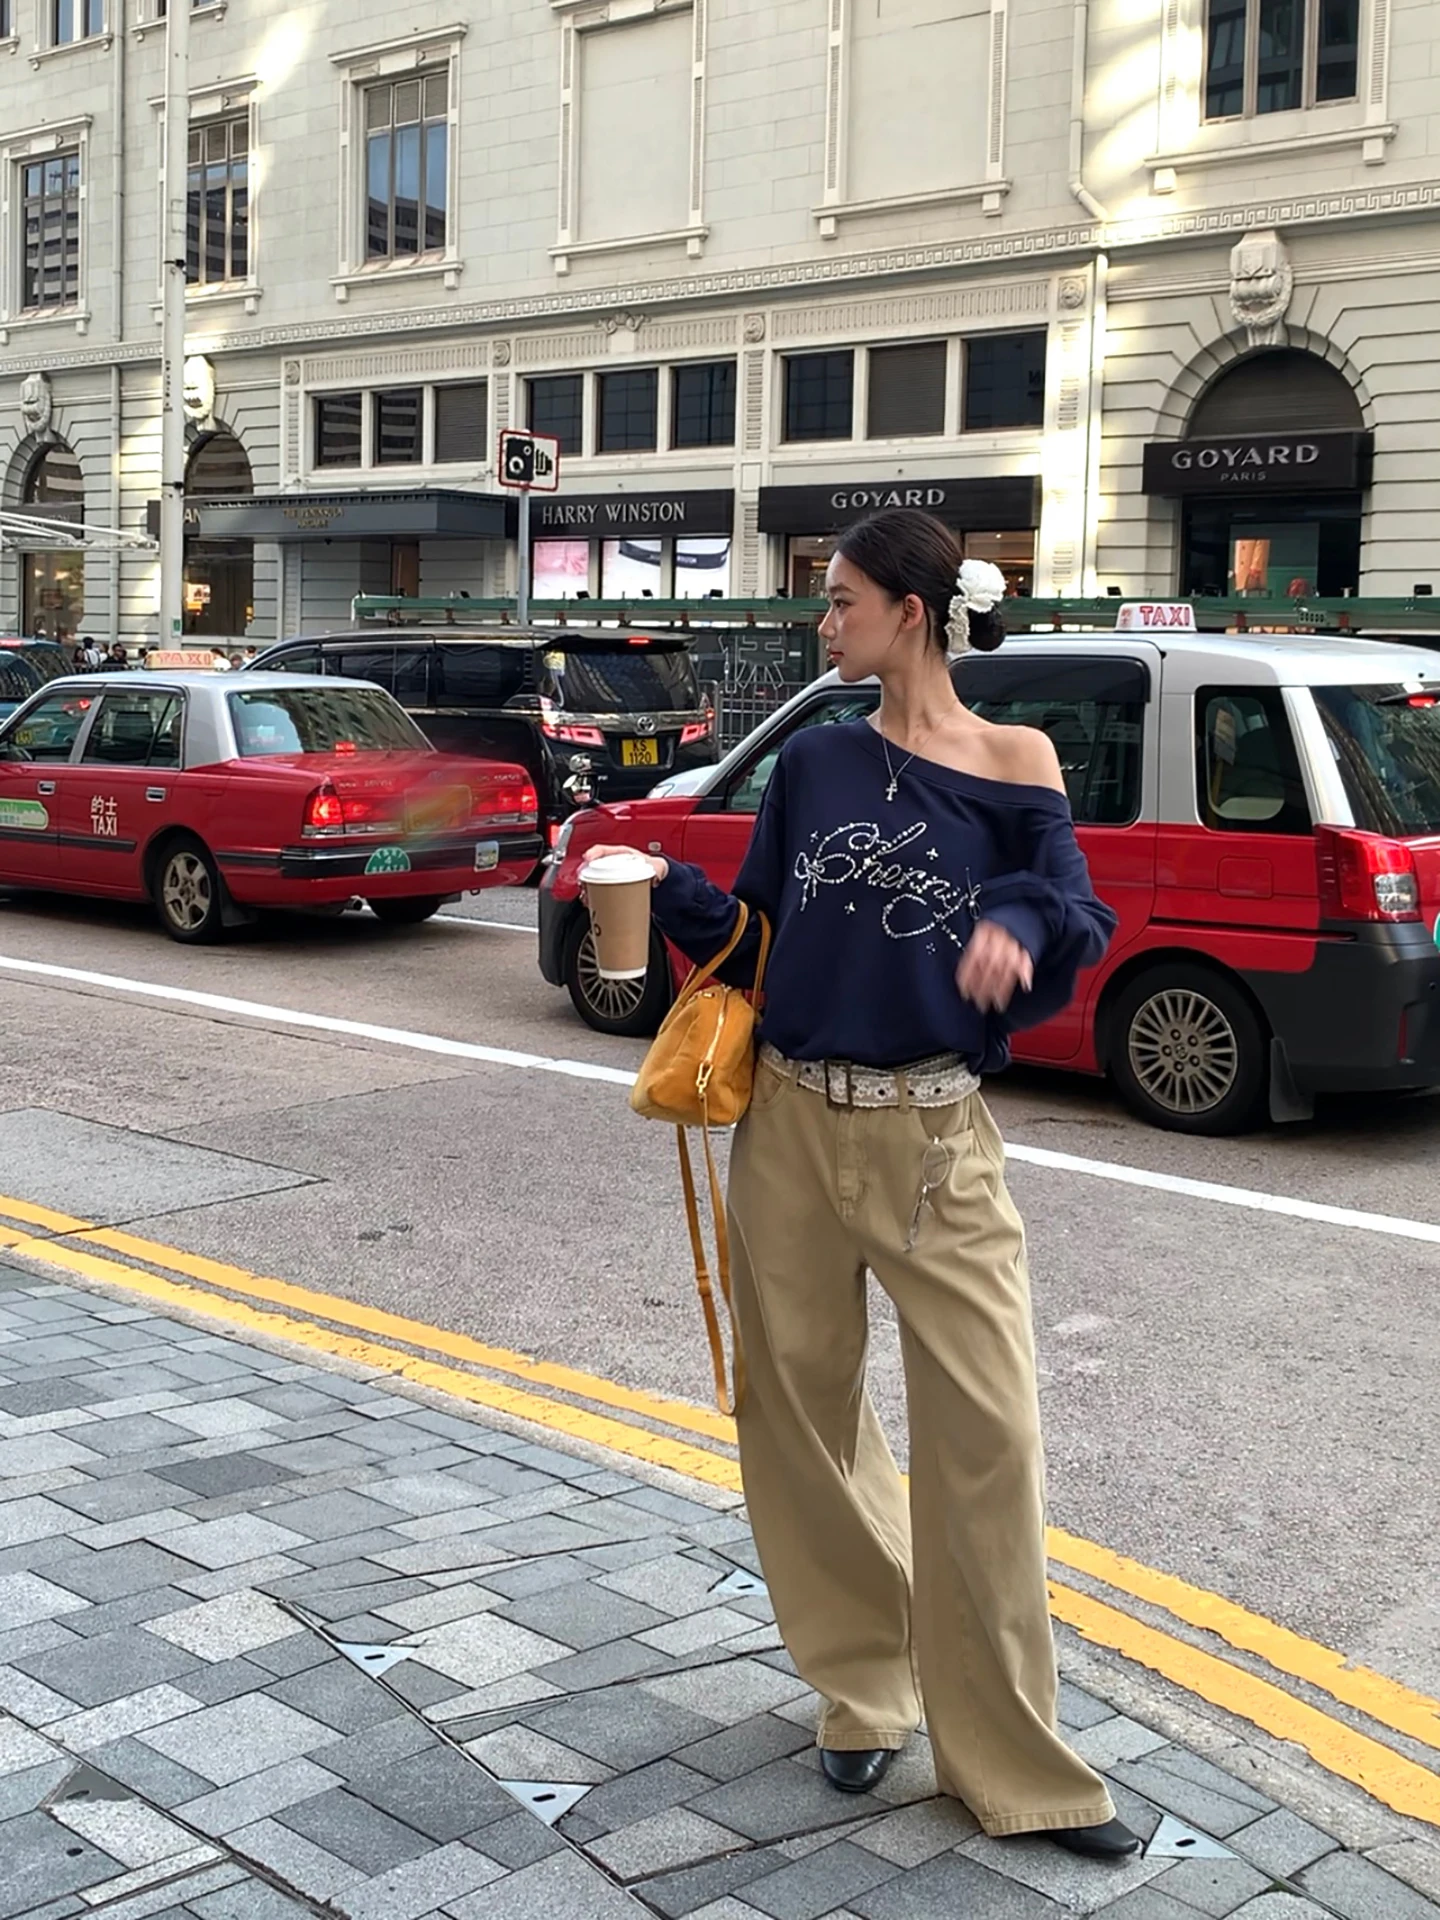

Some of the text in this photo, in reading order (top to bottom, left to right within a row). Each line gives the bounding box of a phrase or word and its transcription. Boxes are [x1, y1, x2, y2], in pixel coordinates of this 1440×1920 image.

[1171, 444, 1319, 469] GOYARD
[1220, 471, 1267, 482] PARIS
[830, 488, 946, 509] GOYARD
[542, 501, 685, 524] HARRY WINSTON
[1139, 605, 1190, 626] TAXI
[157, 651, 212, 665] TAXI
[633, 739, 647, 752] KS
[629, 751, 652, 765] 1120
[90, 795, 118, 815] 的士
[90, 815, 118, 836] TAXI
[371, 864, 405, 873] SEATS
[384, 856, 392, 864] 4
